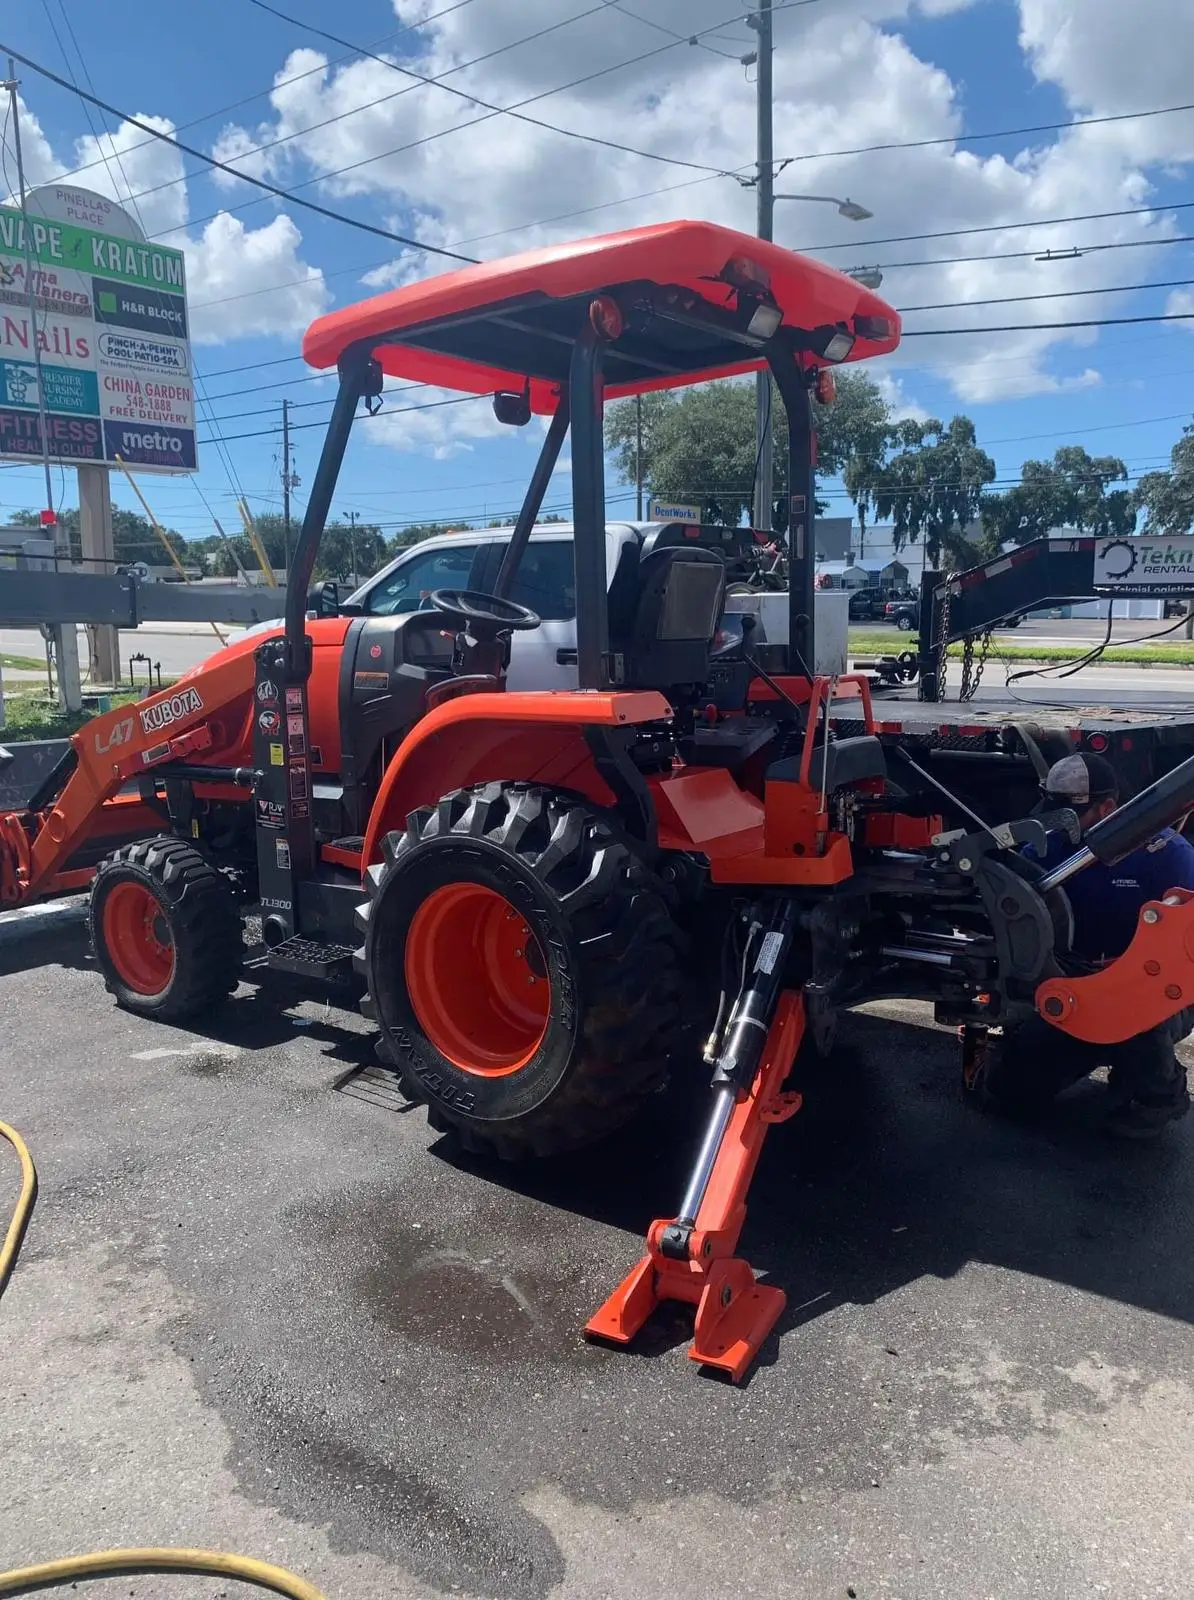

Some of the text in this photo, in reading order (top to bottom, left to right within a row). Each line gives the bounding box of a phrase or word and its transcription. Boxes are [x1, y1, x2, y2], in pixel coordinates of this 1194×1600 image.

[56, 189, 111, 214] PINELLAS
[67, 207, 104, 226] PLACE
[91, 236, 184, 286] KRATOM
[12, 264, 57, 285] Ama
[121, 300, 183, 322] H&R BLOCK
[2, 315, 90, 359] Nails
[104, 376, 190, 402] CHINA GARDEN
[109, 406, 187, 424] FREE DELIVERY
[61, 442, 95, 457] CLUB
[122, 431, 183, 454] metro
[655, 506, 697, 519] DentWorks
[1140, 544, 1194, 564] Tekn
[1144, 565, 1194, 574] RENTAL
[140, 687, 204, 734] KUBOTA
[95, 717, 134, 753] L47
[261, 897, 292, 910] TL1300
[389, 1026, 476, 1110] TITAN
